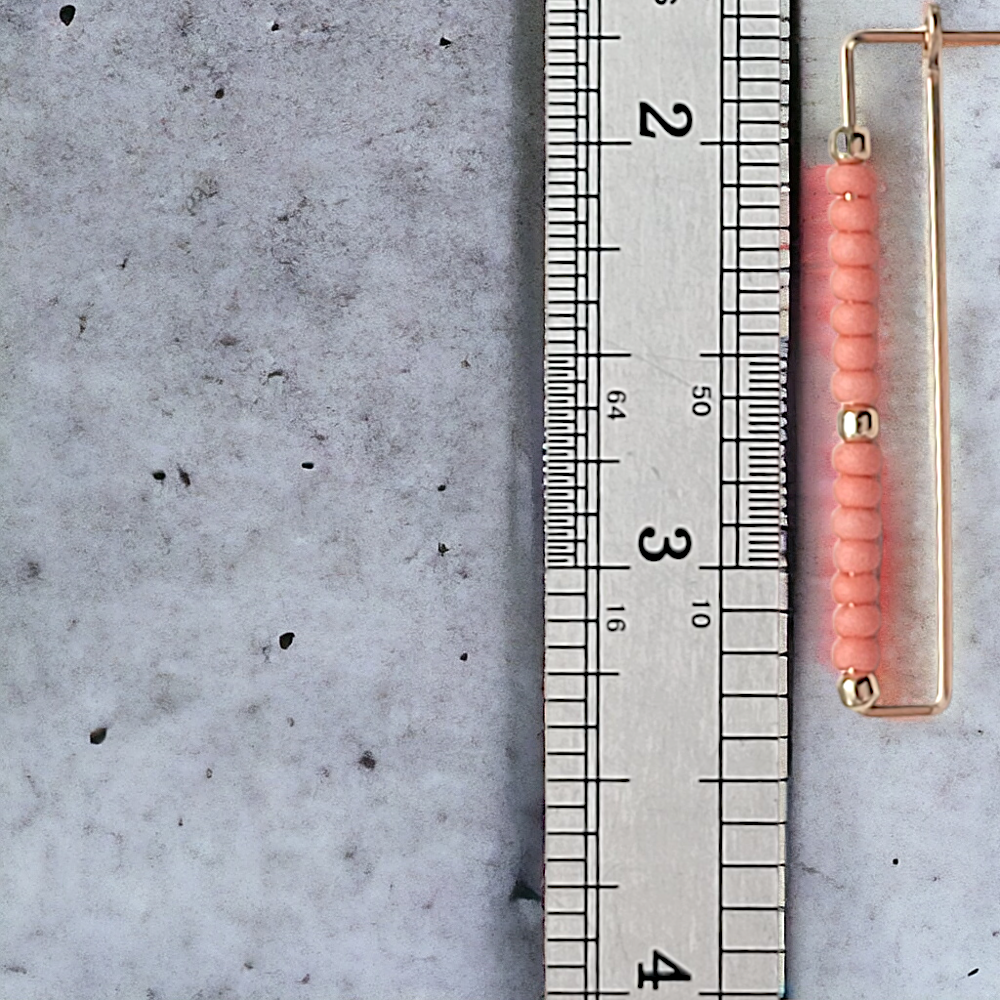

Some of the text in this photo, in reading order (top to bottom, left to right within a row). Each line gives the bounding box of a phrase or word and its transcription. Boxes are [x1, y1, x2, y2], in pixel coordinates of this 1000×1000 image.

[638, 100, 693, 139] 2
[606, 389, 628, 421] 64
[691, 384, 713, 418] 50
[637, 525, 693, 563] 3
[605, 604, 627, 633] 16
[690, 600, 712, 630] 10
[636, 948, 693, 991] 4
